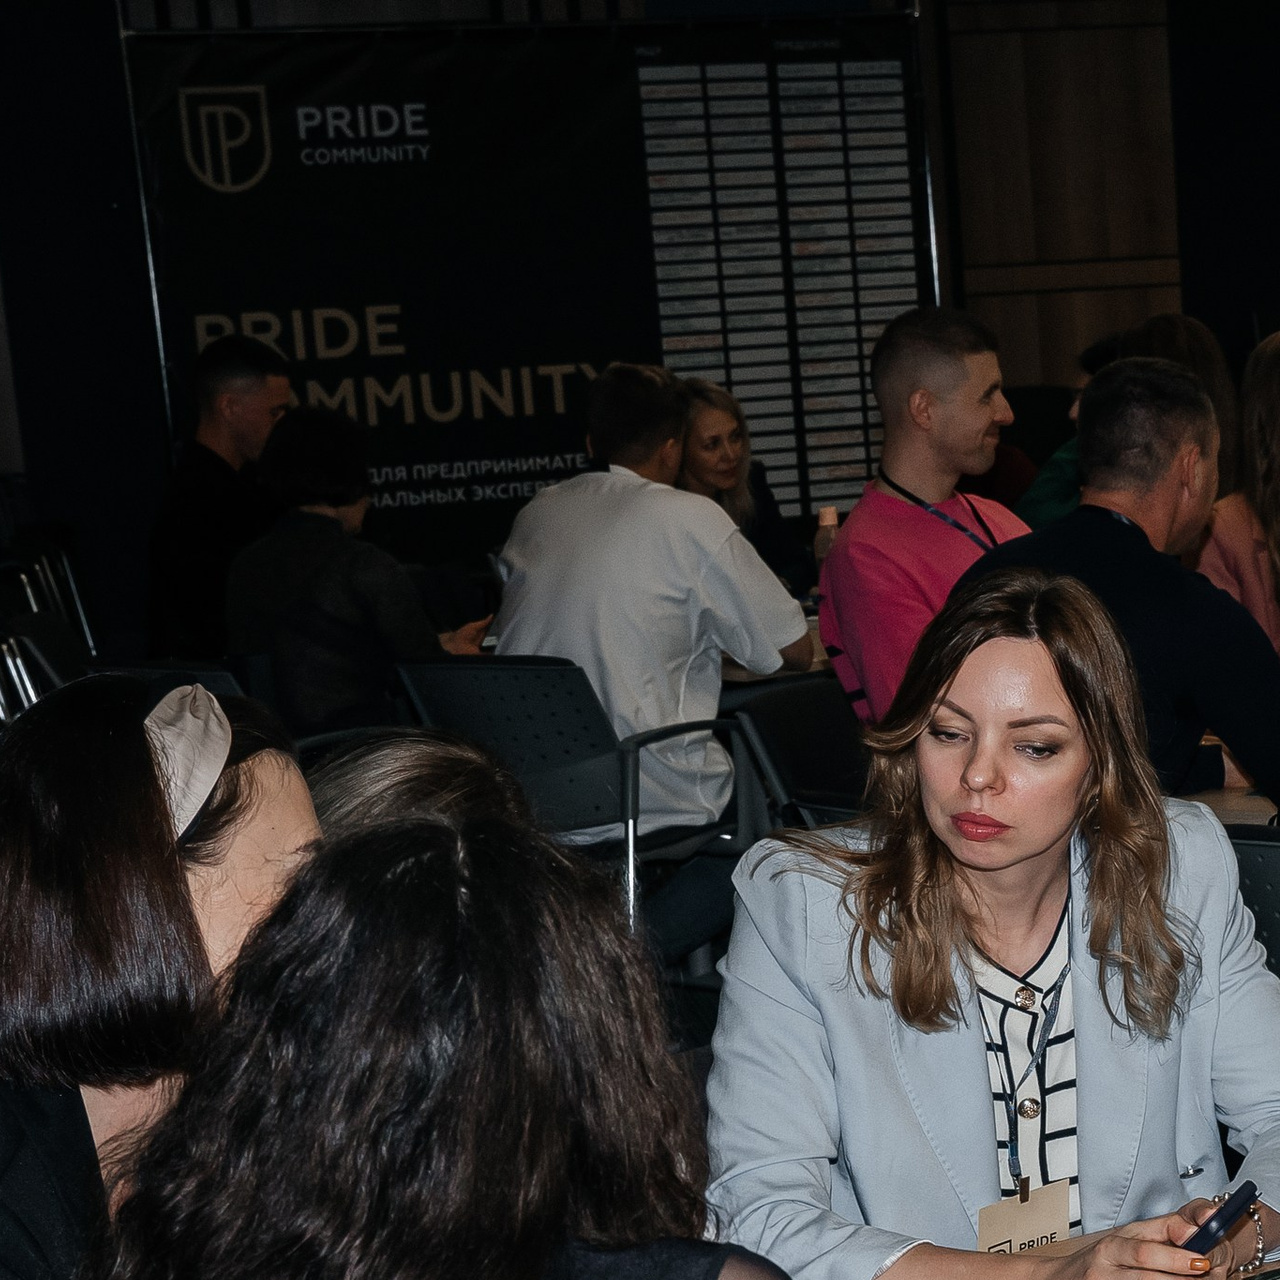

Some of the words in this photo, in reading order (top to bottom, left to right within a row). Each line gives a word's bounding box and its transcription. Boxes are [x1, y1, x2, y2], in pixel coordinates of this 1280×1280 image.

[296, 102, 430, 140] PRIDE
[299, 142, 431, 166] COMMUNITY
[289, 361, 600, 428] MMUNIT
[469, 479, 560, 502] ЭКСПЕР
[1019, 1231, 1058, 1252] PRIDE
